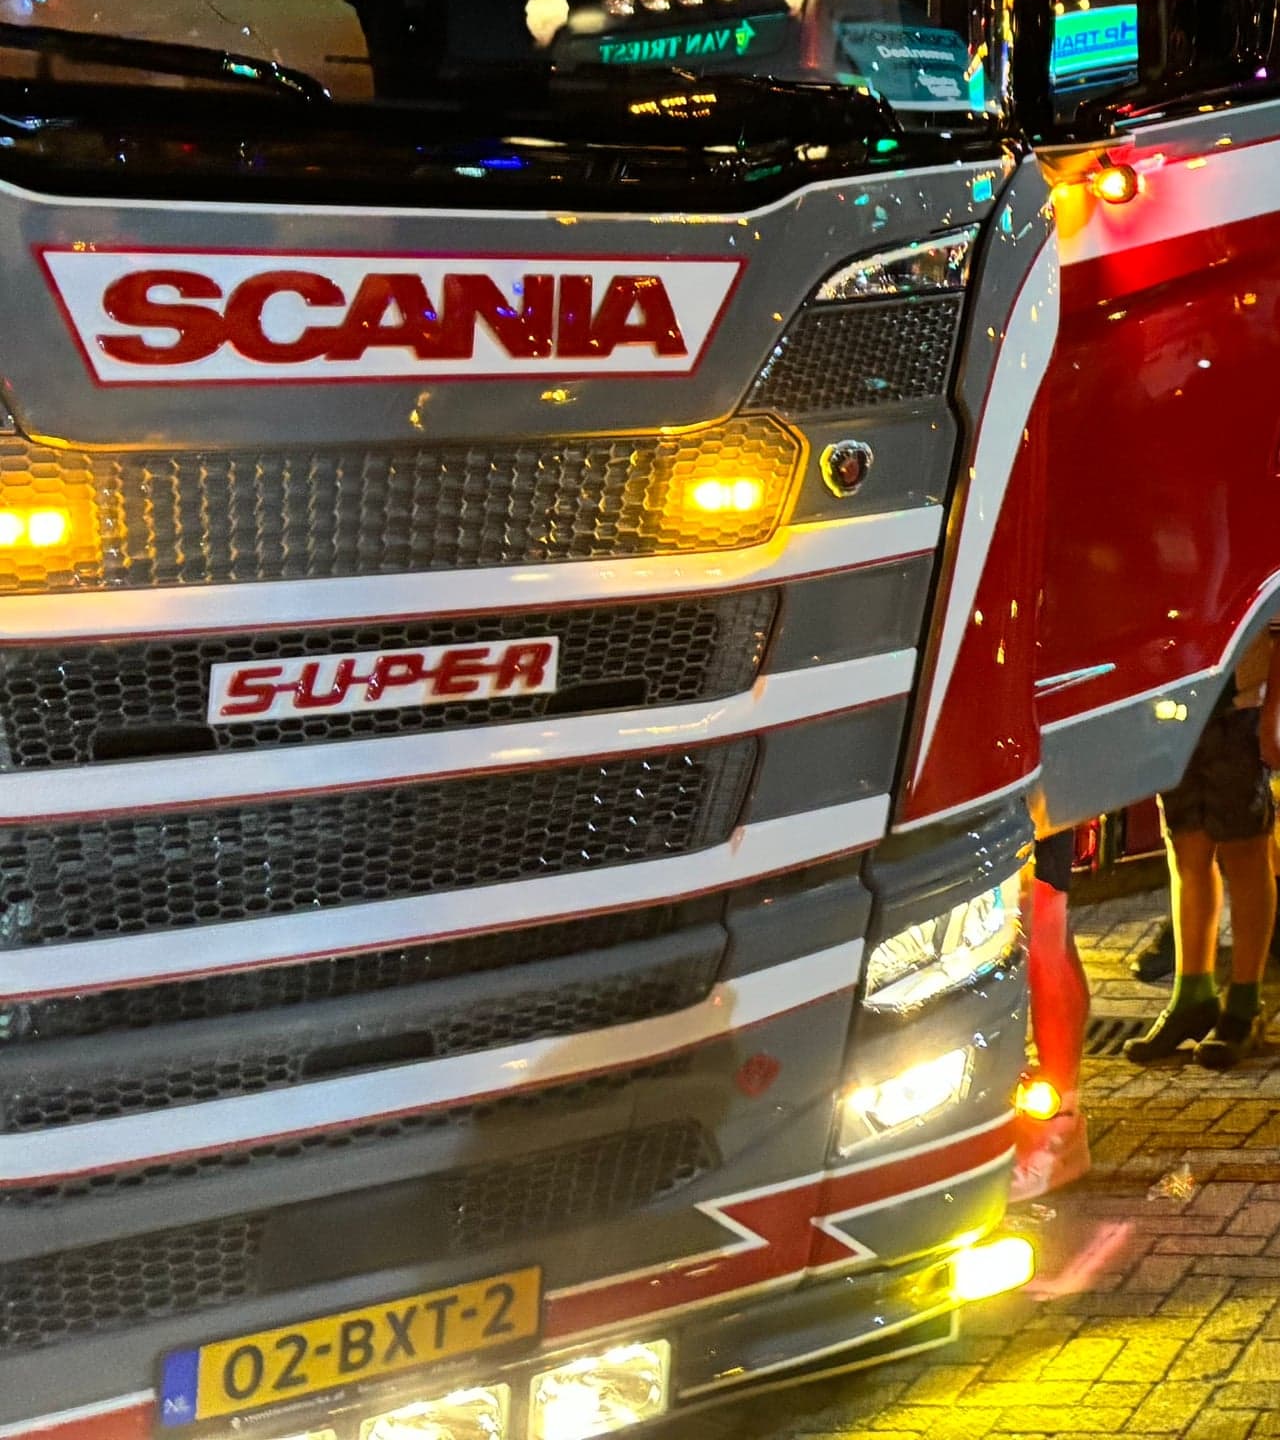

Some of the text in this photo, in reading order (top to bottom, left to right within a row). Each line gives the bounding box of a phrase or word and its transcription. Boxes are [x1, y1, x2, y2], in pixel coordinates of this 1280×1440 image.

[95, 268, 688, 364] SCANIA
[219, 641, 552, 717] SUPER
[222, 1282, 516, 1401] 02-BXT-2
